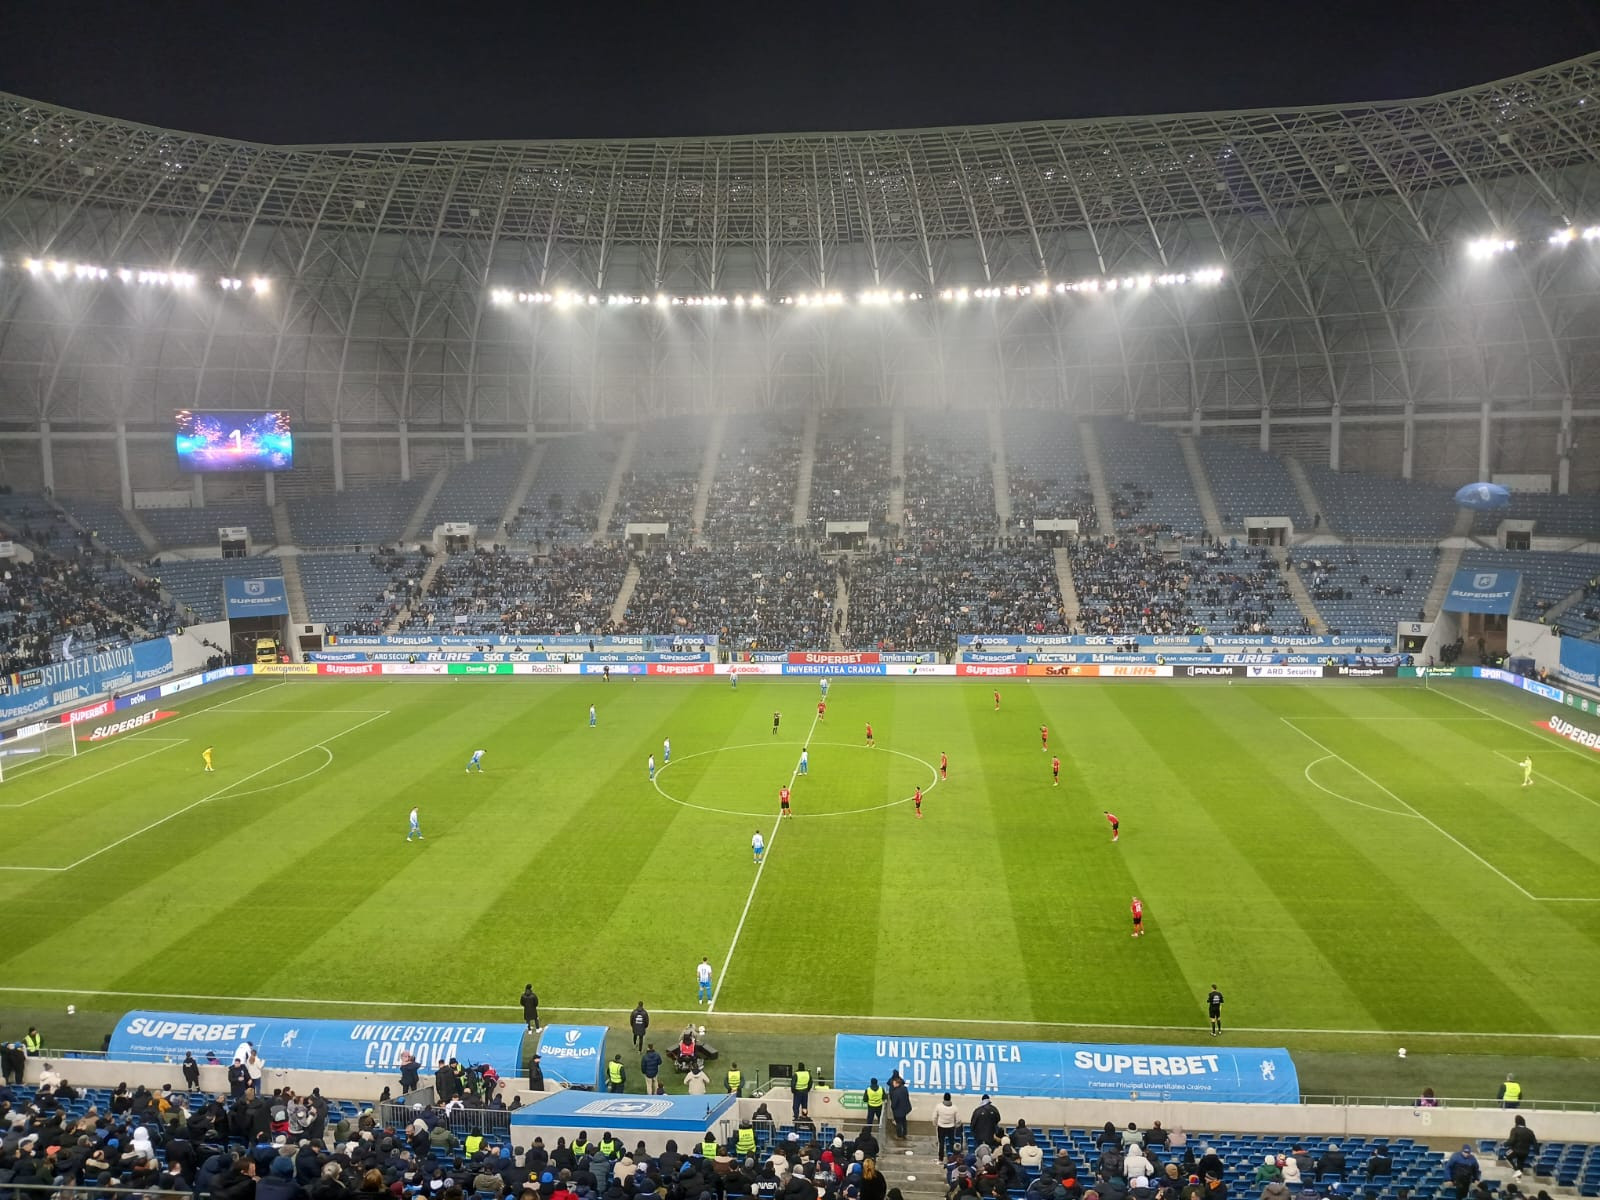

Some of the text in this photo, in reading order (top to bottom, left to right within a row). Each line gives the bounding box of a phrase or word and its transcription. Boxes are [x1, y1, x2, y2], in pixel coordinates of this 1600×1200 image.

[229, 429, 242, 451] 1
[1452, 590, 1511, 599] SUPERBET
[230, 596, 282, 604] SUPERBET
[340, 637, 380, 645] TeraSteel
[386, 636, 433, 645] SUPERLIGA
[1026, 635, 1072, 645] SUPERBET
[1216, 637, 1264, 645] TeraSteel
[1271, 635, 1325, 645] SUPERLIGA
[93, 647, 135, 673] CRAIOVA
[315, 653, 356, 661] SUPERSCORE
[427, 652, 473, 661] RURIS
[660, 653, 702, 661] SUPERSCORE
[806, 653, 862, 664] SUPERBET
[971, 653, 1016, 662] SUPERSCORE
[1222, 654, 1275, 663] RURIS
[326, 664, 373, 674] SUPERBET
[656, 664, 705, 674] SUPERBET
[786, 664, 881, 673] UNIVERSITATEA CRAIOVA
[965, 665, 1018, 675] SUPERBET
[1113, 667, 1157, 675] RURIS
[53, 685, 80, 705] PUMA
[70, 703, 108, 722] SUPERBET
[90, 709, 160, 741] SUPERBET
[126, 1018, 257, 1042] SUPERBET
[350, 1024, 487, 1043] UNIVERSITATEA
[540, 1045, 597, 1059] SUPERLIGA
[876, 1040, 1022, 1063] UNIVERSITATEA
[1074, 1051, 1219, 1076] SUPERBET
[899, 1059, 999, 1092] CRAIOVA
[757, 1182, 777, 1190] NASA
